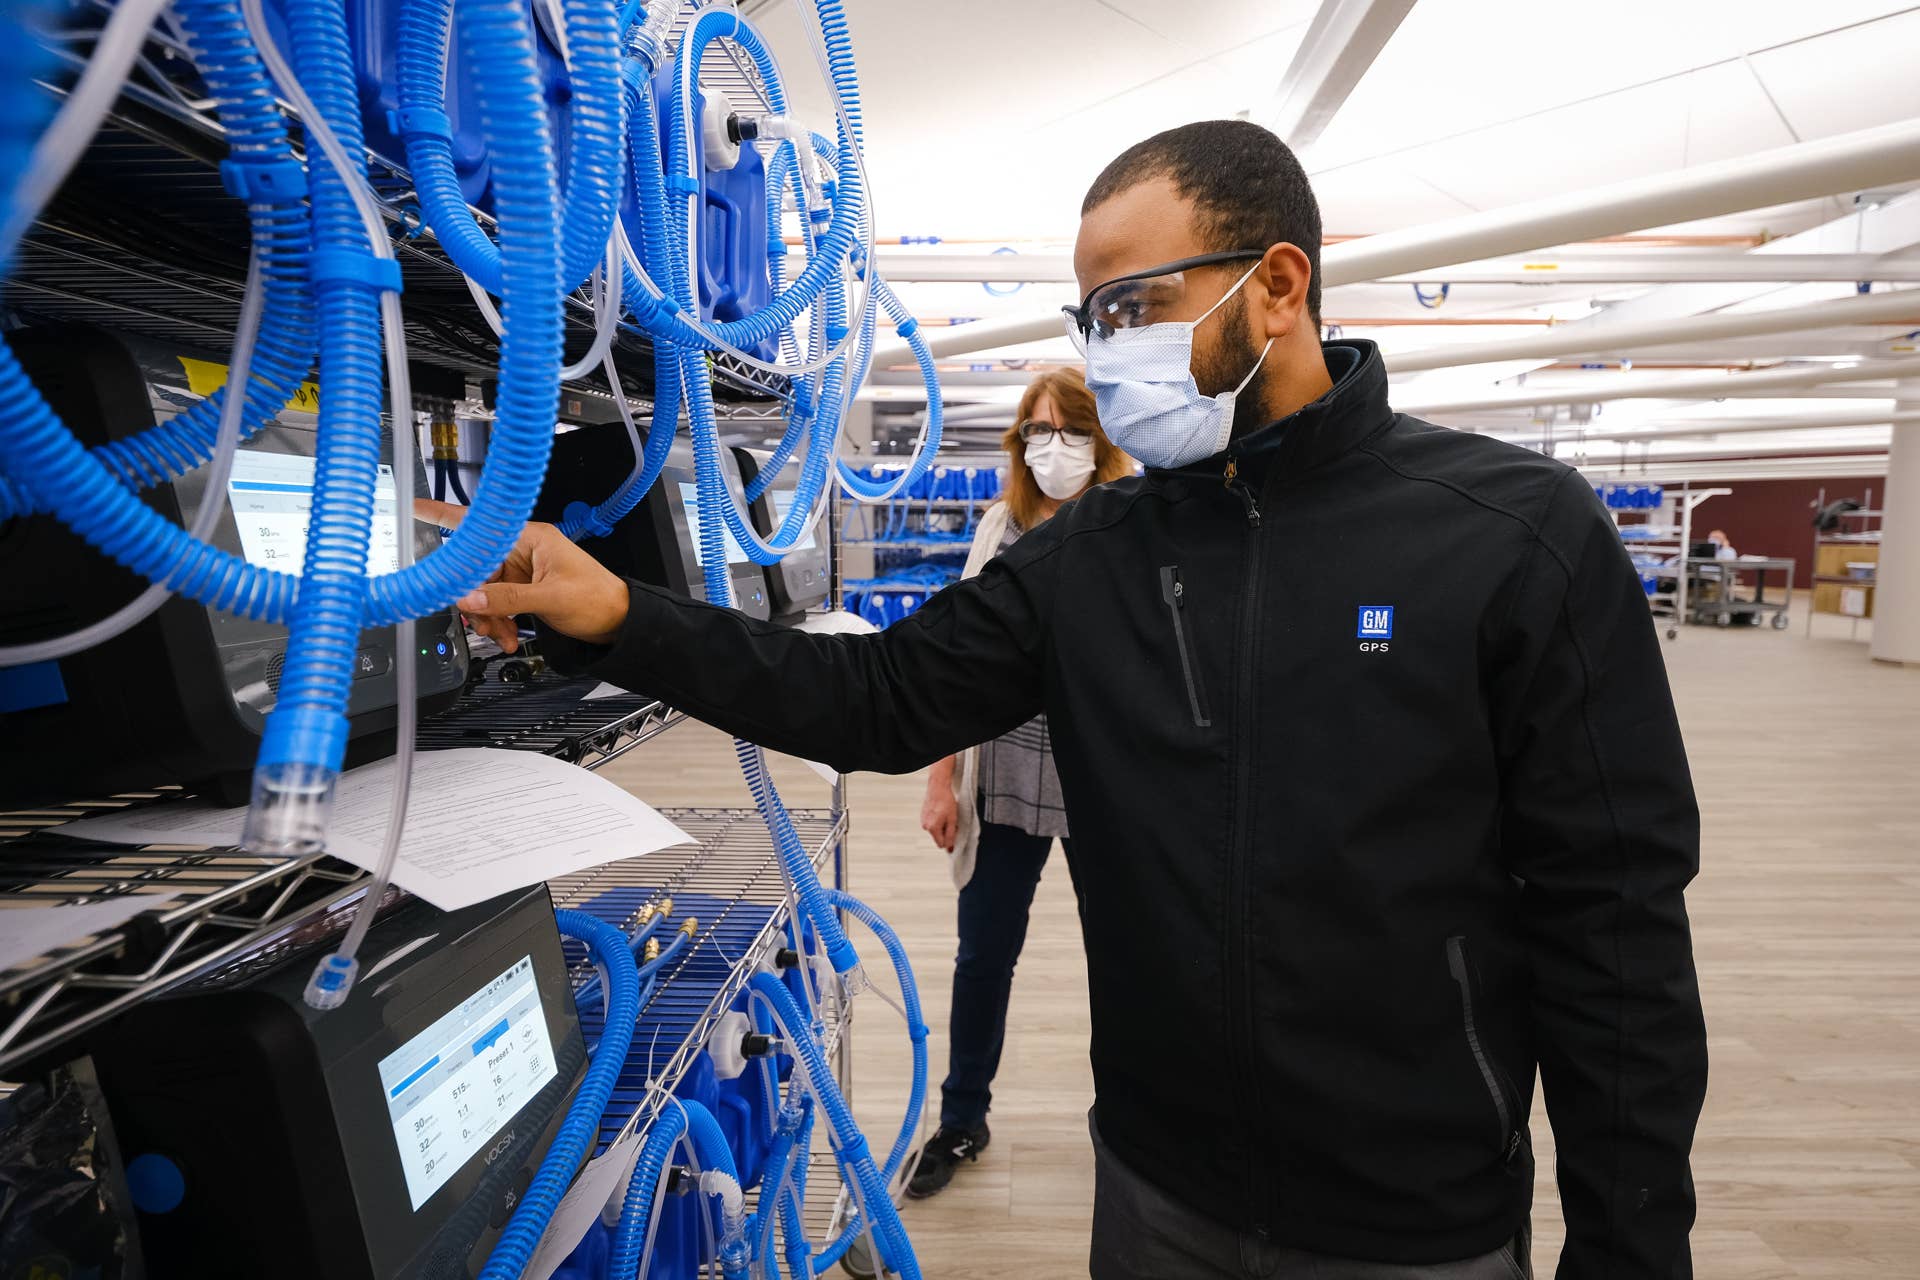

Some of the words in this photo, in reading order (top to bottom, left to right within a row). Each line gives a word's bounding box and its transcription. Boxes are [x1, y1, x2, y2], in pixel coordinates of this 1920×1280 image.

[258, 527, 270, 537] 30
[264, 549, 276, 559] 32
[1362, 610, 1388, 630] GM
[1359, 642, 1389, 652] GPS
[488, 1047, 509, 1068] Preset
[452, 1082, 466, 1100] 515
[497, 1094, 505, 1107] 21
[414, 1118, 425, 1133] 30
[419, 1138, 430, 1153] 32
[424, 1159, 435, 1174] 20
